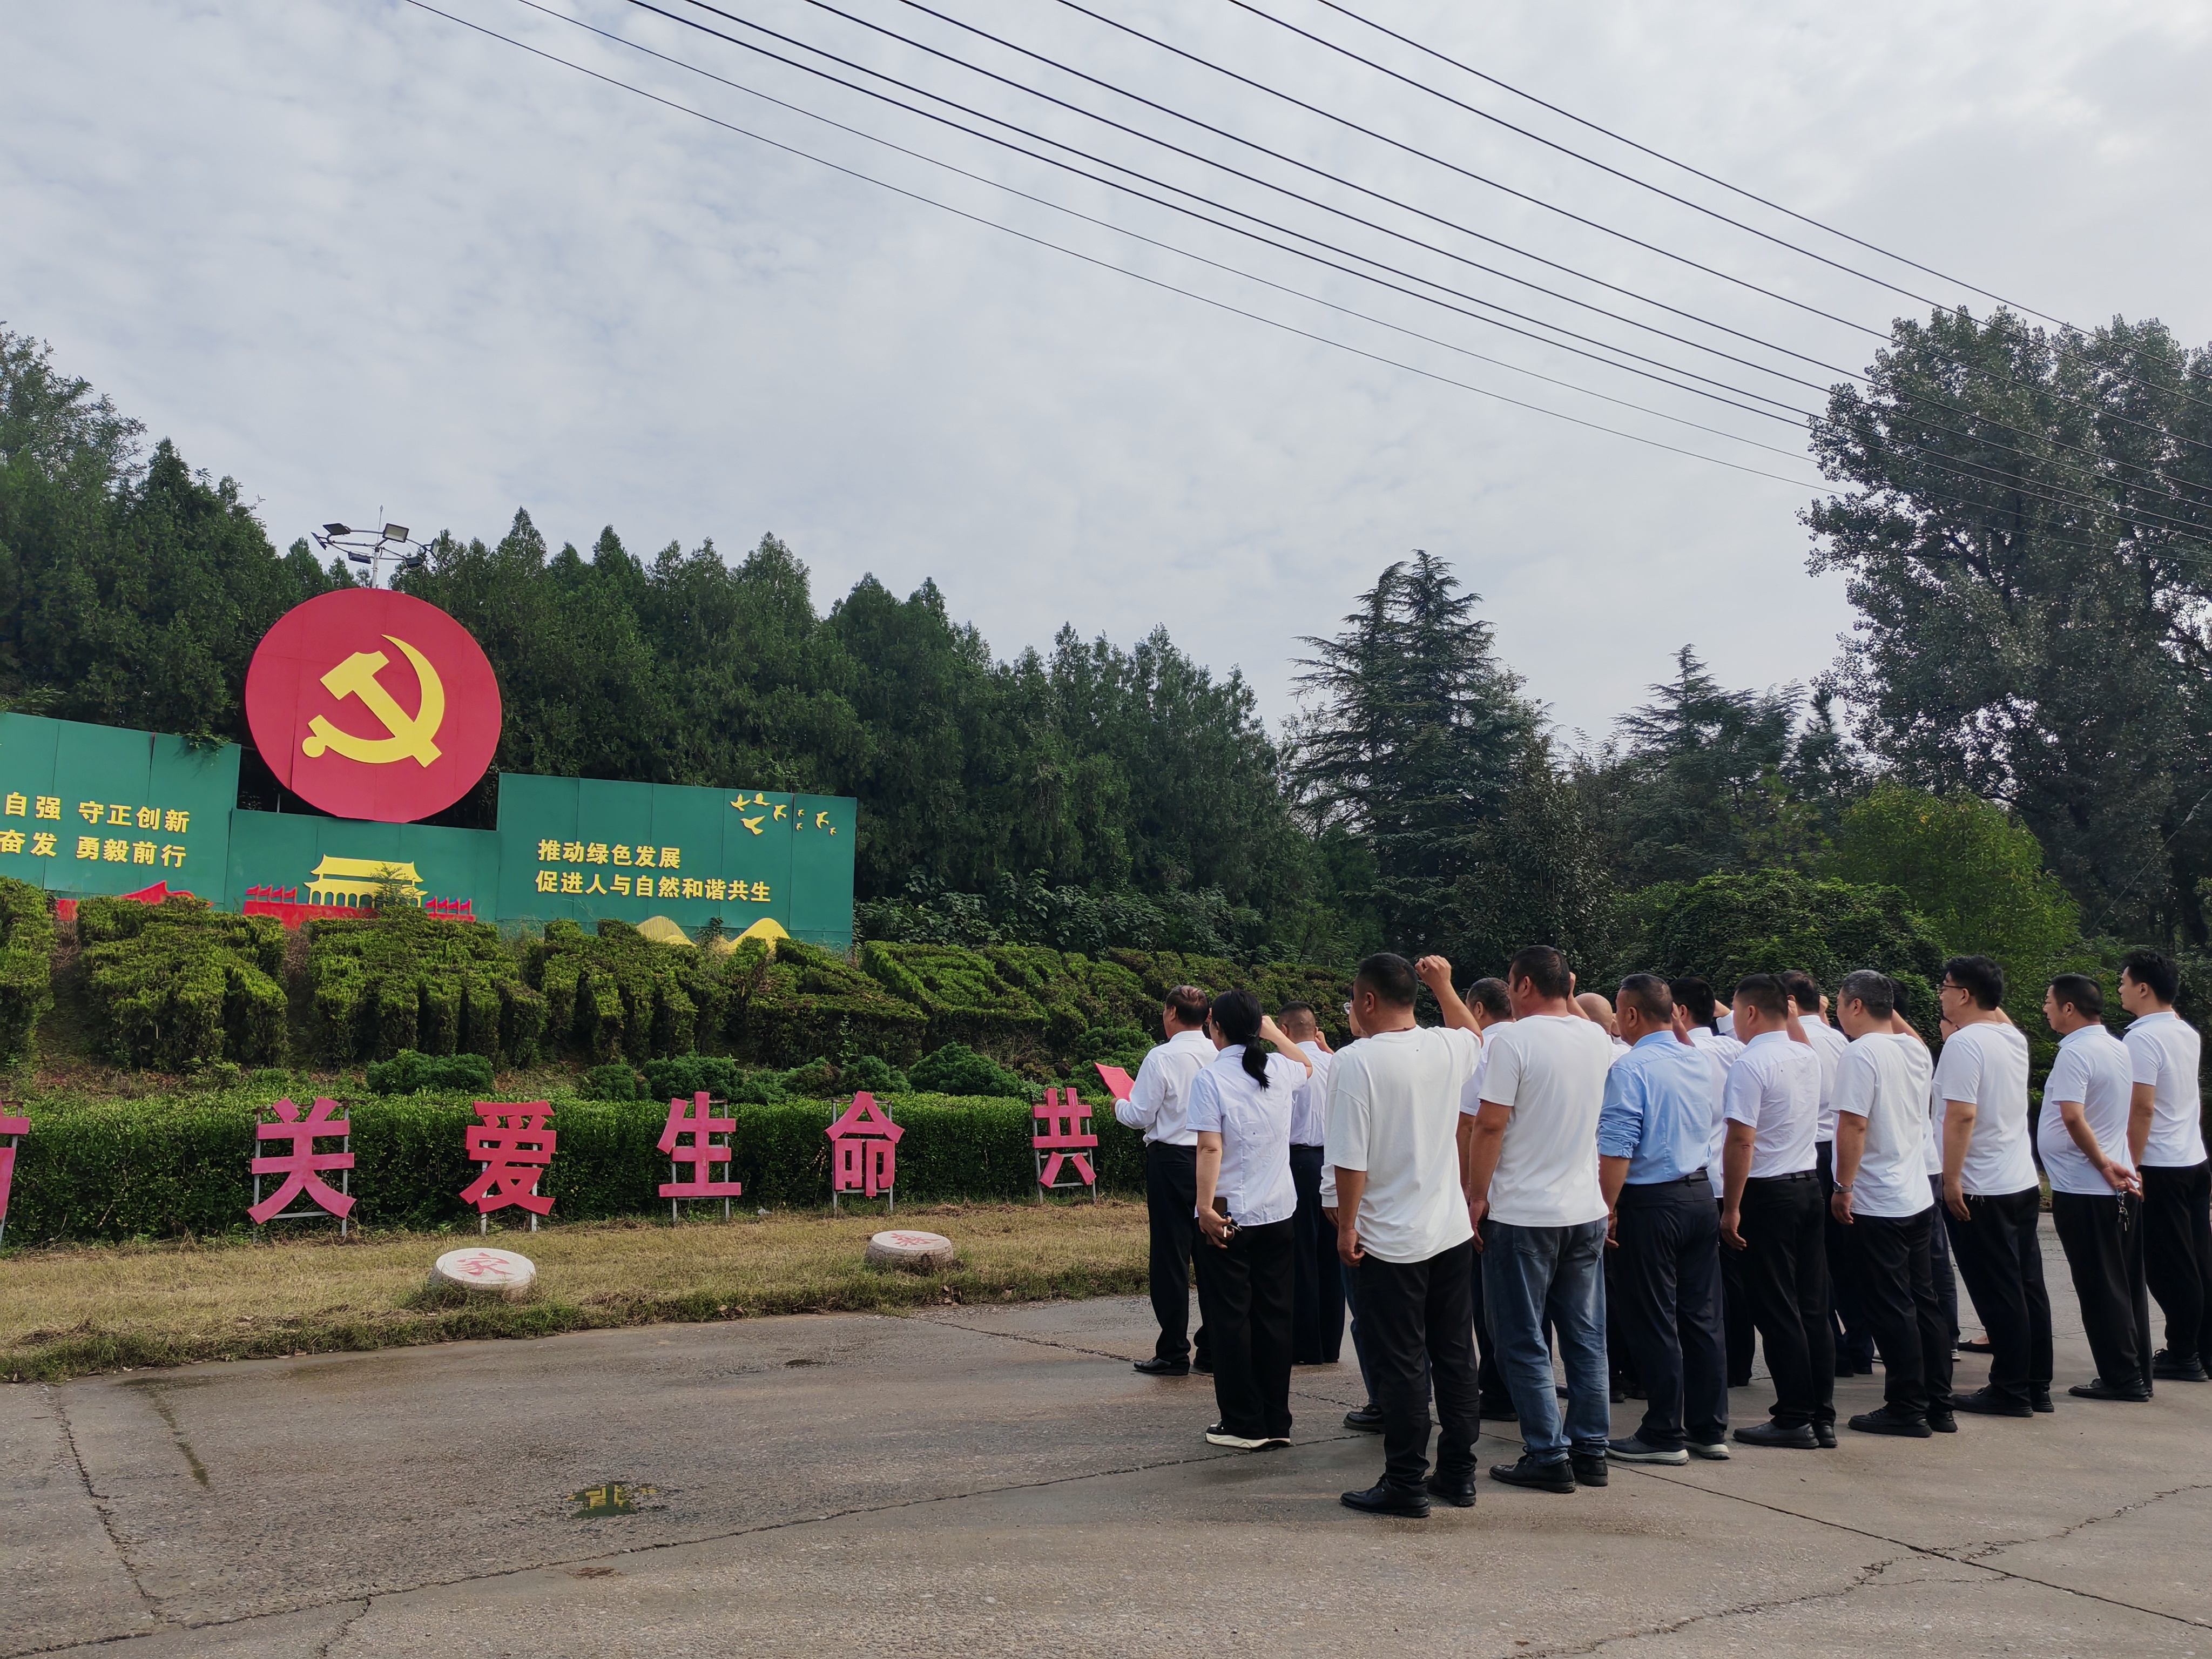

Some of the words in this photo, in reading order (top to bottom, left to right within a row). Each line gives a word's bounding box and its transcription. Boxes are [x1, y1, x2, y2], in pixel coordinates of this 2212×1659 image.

[5, 791, 61, 820] 自强
[78, 800, 190, 833] 守正创新
[0, 829, 57, 857] 奋发
[75, 835, 186, 868] 勇毅前行
[537, 839, 681, 869] 推动绿色发展
[535, 869, 771, 902] 促进人与自然和谐共生
[456, 1252, 515, 1276] 家
